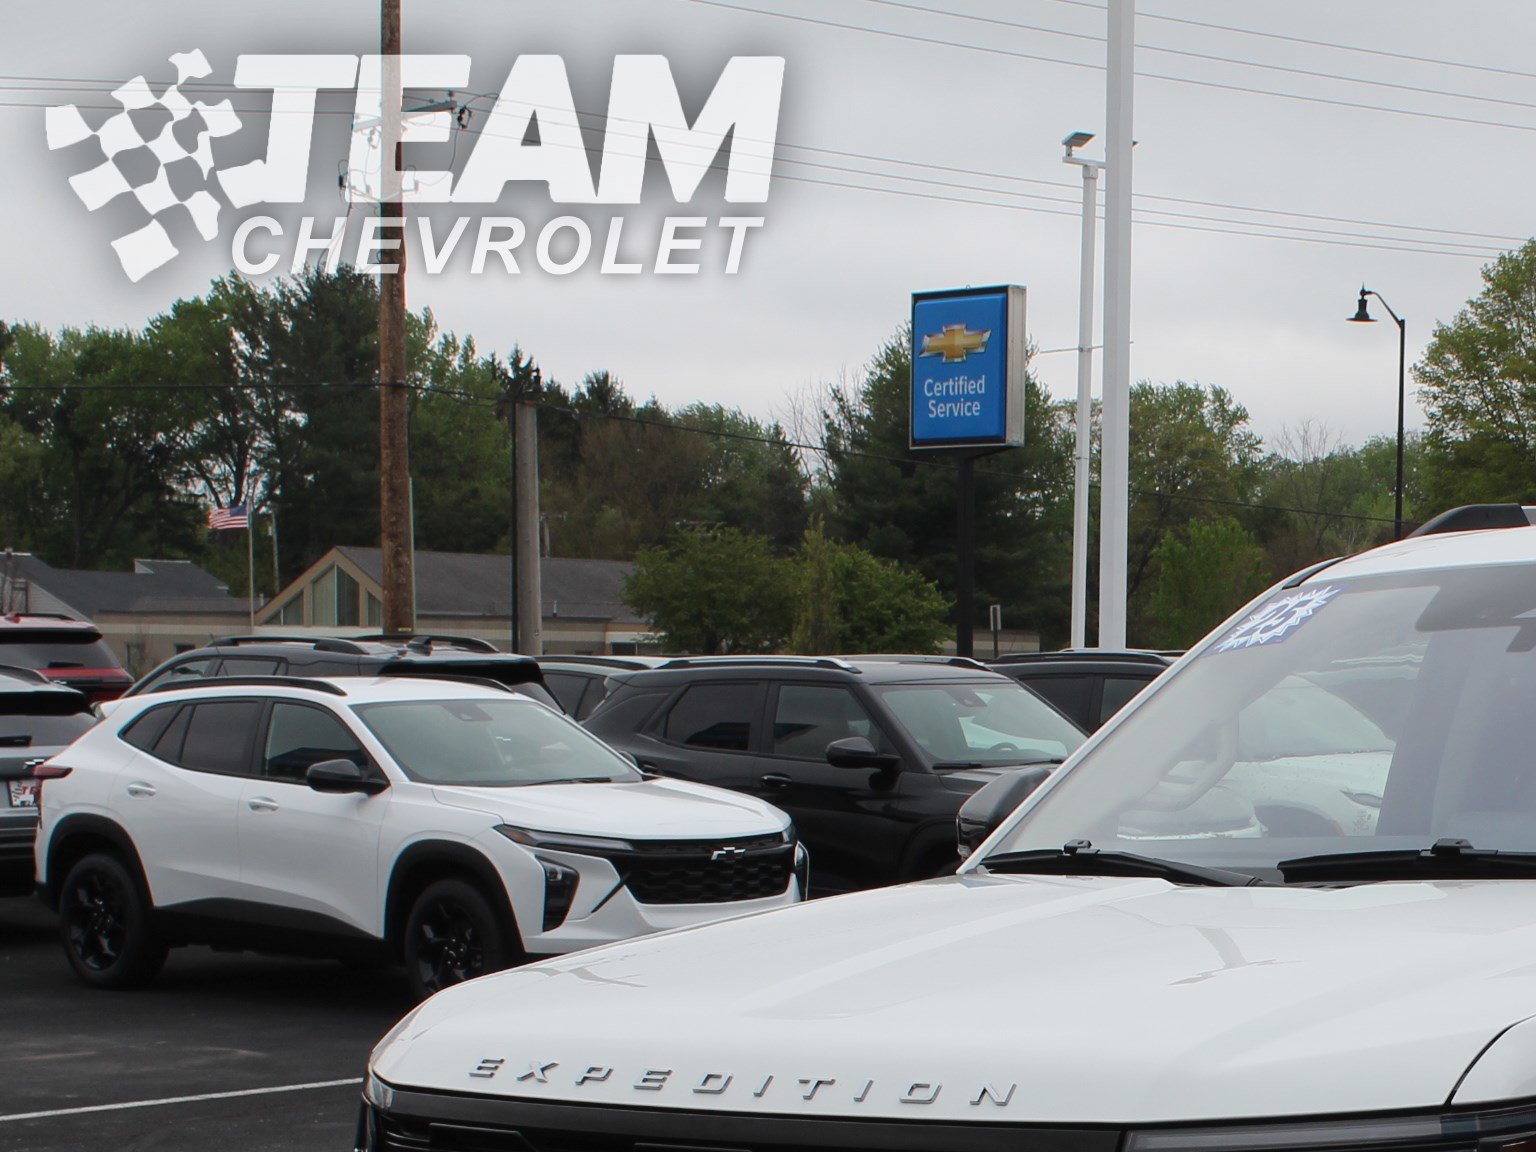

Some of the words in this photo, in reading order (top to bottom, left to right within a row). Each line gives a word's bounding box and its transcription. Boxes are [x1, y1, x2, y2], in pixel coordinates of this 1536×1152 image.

[923, 374, 986, 397] Certified
[928, 398, 981, 418] Service
[467, 1056, 1023, 1108] EXPEDITION
